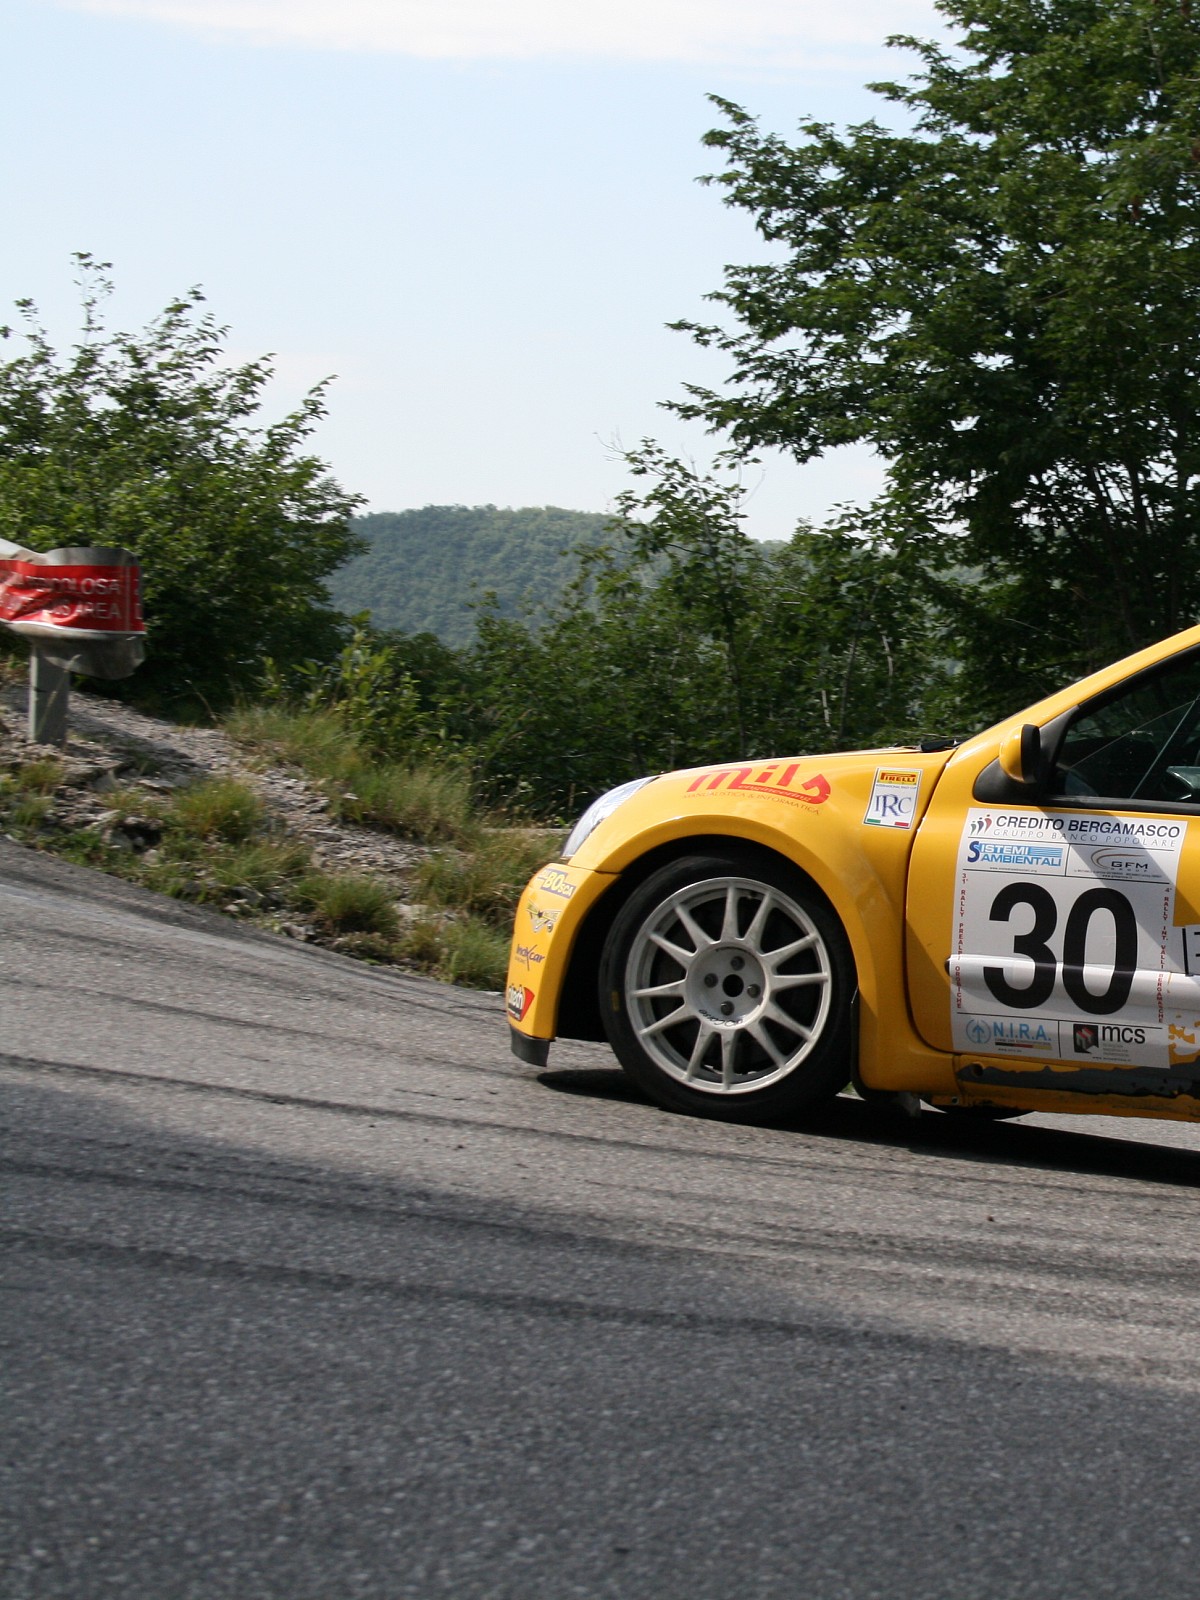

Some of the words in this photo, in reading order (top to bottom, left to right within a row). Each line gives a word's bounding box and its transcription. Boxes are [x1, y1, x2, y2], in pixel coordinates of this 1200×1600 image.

[880, 772, 917, 783] PIRELLI
[757, 794, 819, 815] INFORMATICA
[874, 793, 912, 817] IRC
[996, 815, 1064, 831] CREDITO
[1067, 819, 1180, 839] BERGAMASCO
[993, 828, 1044, 839] GRUPPO
[1051, 832, 1098, 843] BANCO
[1105, 835, 1176, 848] POPOLARE
[981, 853, 1062, 867] AMBIENTALI
[1110, 860, 1149, 870] GFM
[959, 889, 967, 918] RALLY
[983, 881, 1139, 1016] 30
[1101, 1025, 1146, 1044] mcs
